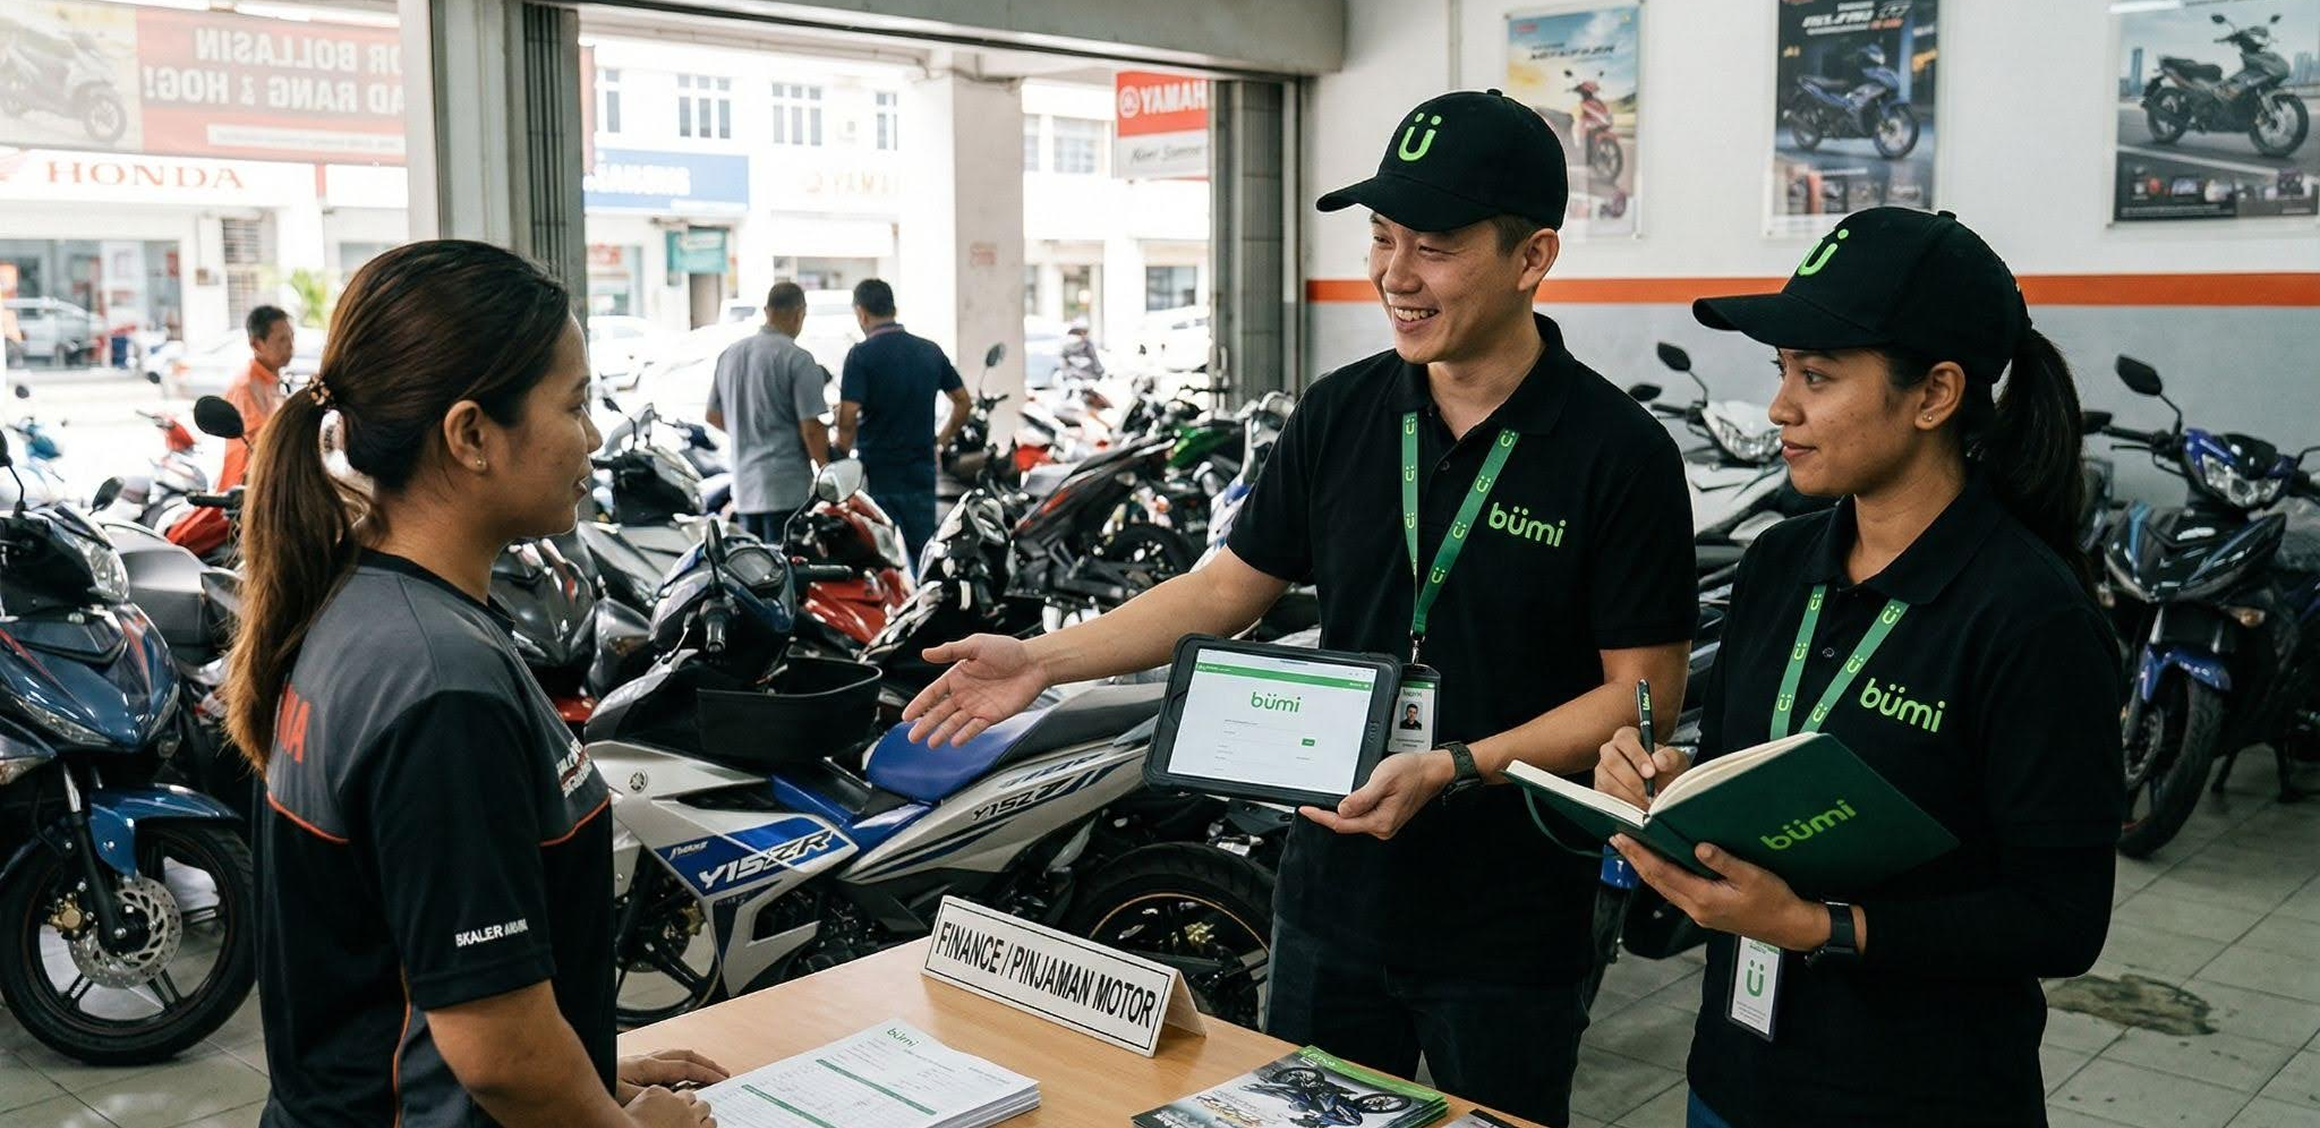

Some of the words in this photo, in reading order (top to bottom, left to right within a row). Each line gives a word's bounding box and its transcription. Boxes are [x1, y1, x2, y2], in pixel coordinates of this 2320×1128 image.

[47, 161, 244, 189] HONDA
[1488, 502, 1566, 547] bümi
[1250, 691, 1302, 713] bümi
[1859, 677, 1946, 733] bümi
[1759, 799, 1857, 850] bümi
[936, 921, 1004, 975] FINANCE
[1000, 943, 1014, 976] /
[1008, 945, 1095, 1007] PINJAMAN
[1092, 971, 1156, 1029] MOTOR
